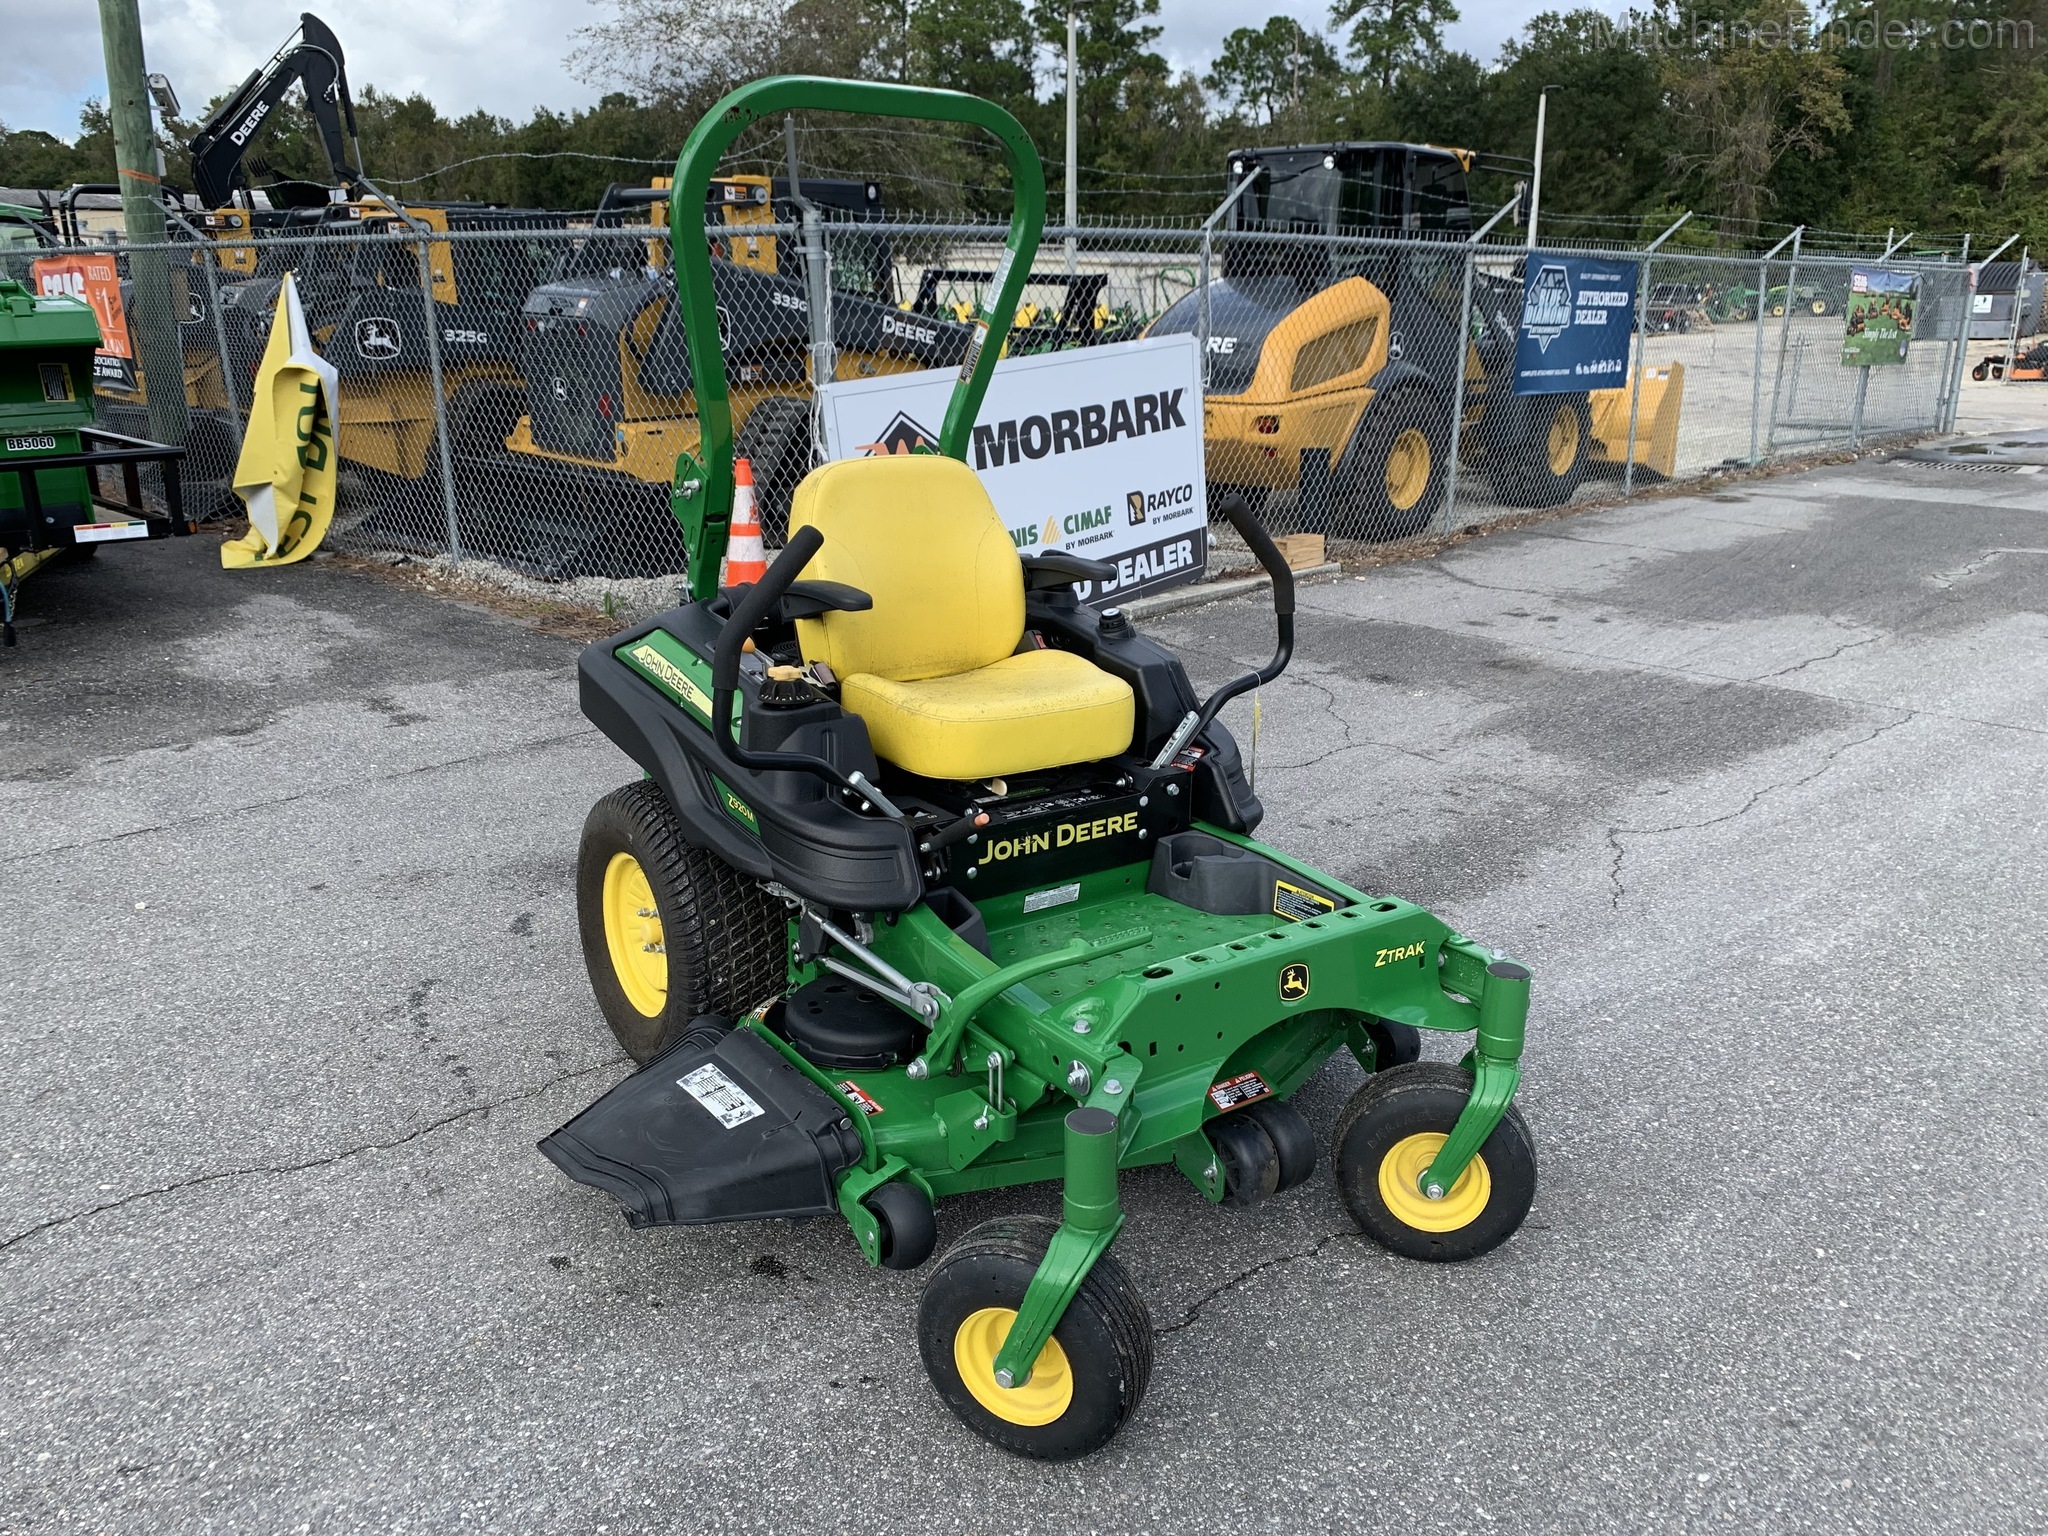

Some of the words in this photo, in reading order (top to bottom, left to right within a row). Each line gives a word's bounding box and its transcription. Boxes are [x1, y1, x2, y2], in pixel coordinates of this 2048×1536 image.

[230, 100, 270, 146] DEERE
[87, 265, 111, 281] RATED
[772, 292, 807, 312] 333G
[1538, 289, 1563, 306] BLUE
[1576, 290, 1629, 307] AUTHORIZED
[1524, 305, 1570, 325] DIAMOND
[1574, 310, 1607, 325] DEALER
[445, 329, 487, 343] 325G
[882, 315, 937, 345] DEERE
[102, 366, 123, 378] AWARD
[973, 388, 1187, 471] MORBARK
[8, 437, 54, 450] BB5060
[1147, 484, 1193, 512] RAYCO
[1063, 505, 1112, 535] CIMAF
[1152, 515, 1161, 525] BY
[1163, 507, 1194, 523] MORBARK
[1065, 541, 1076, 551] BY
[1078, 531, 1114, 548] MORBARK
[640, 648, 665, 676] JOHN
[665, 665, 694, 700] DEERE
[978, 831, 1049, 865] JOHN
[1057, 811, 1138, 848] DEERE
[1374, 940, 1427, 968] ZTRAK
